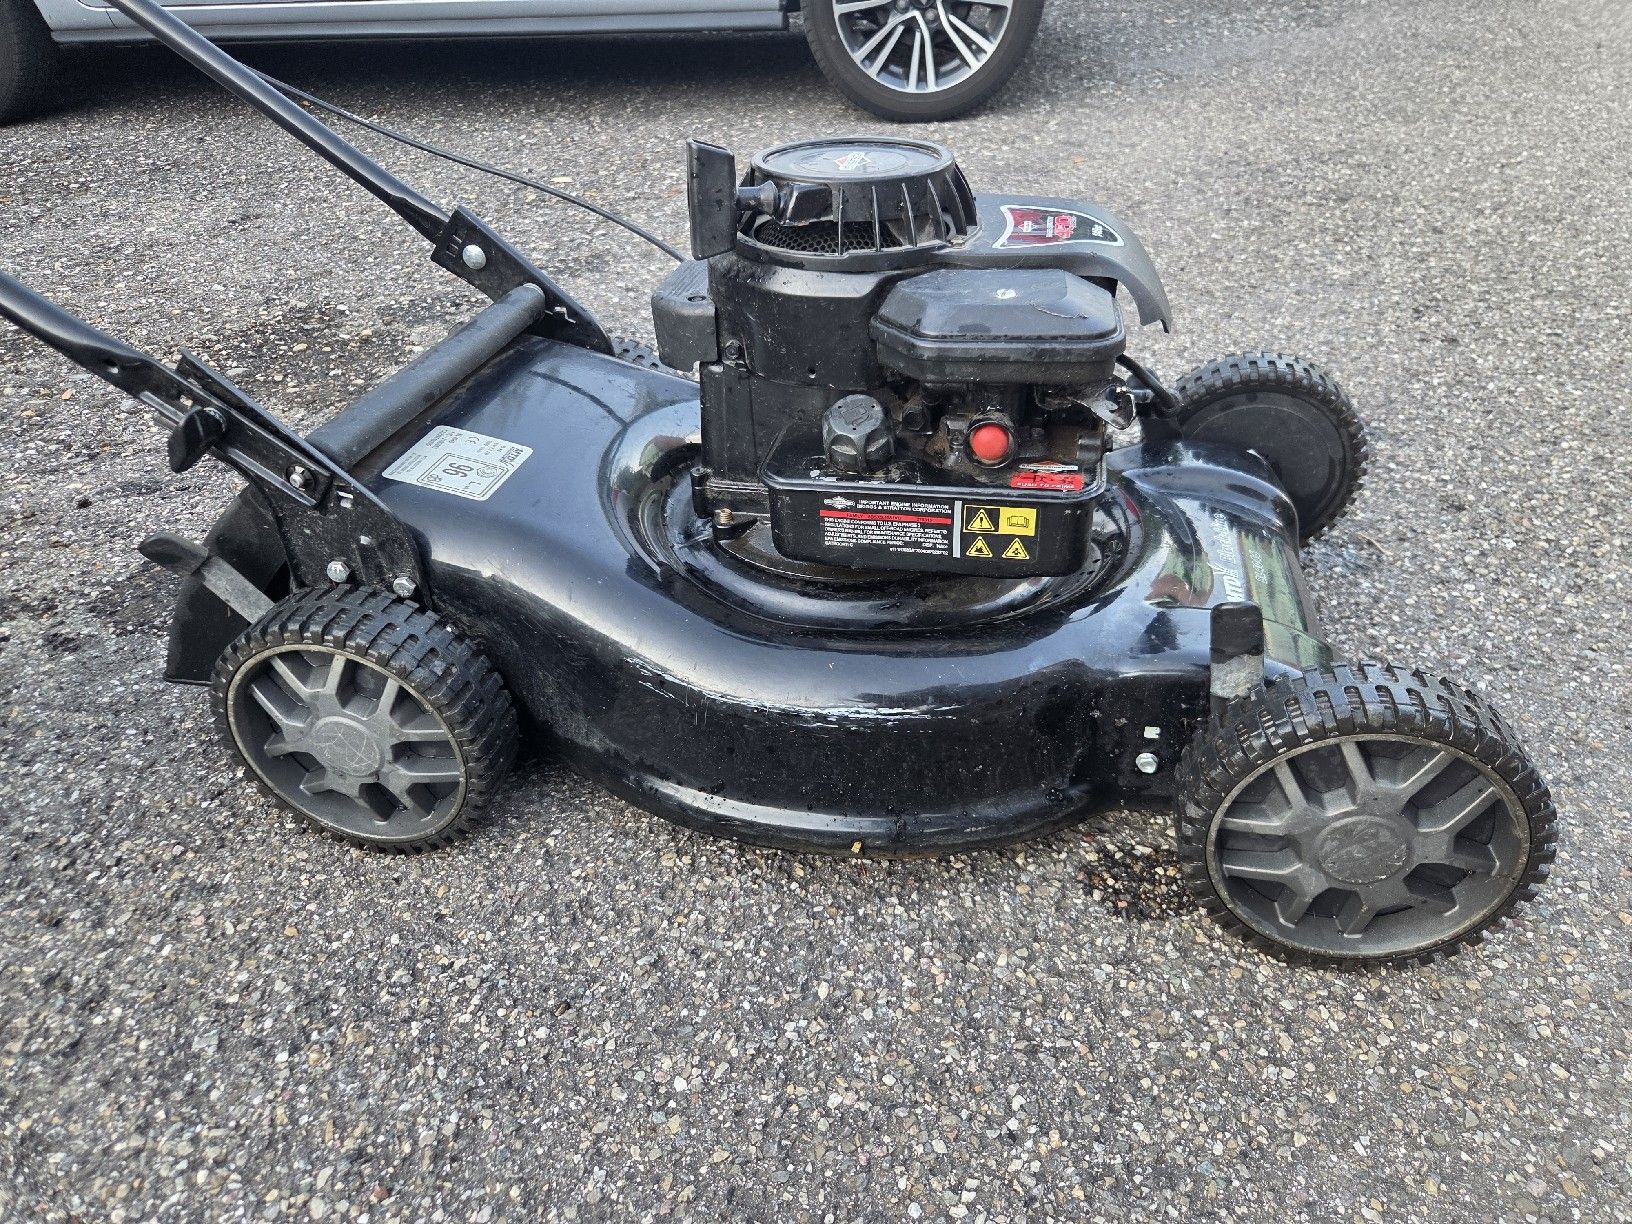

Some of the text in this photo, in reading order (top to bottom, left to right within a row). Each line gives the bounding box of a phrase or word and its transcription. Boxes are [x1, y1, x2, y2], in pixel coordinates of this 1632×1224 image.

[442, 462, 475, 478] 96
[883, 504, 912, 512] STRATTON
[911, 506, 951, 514] CORPORATION
